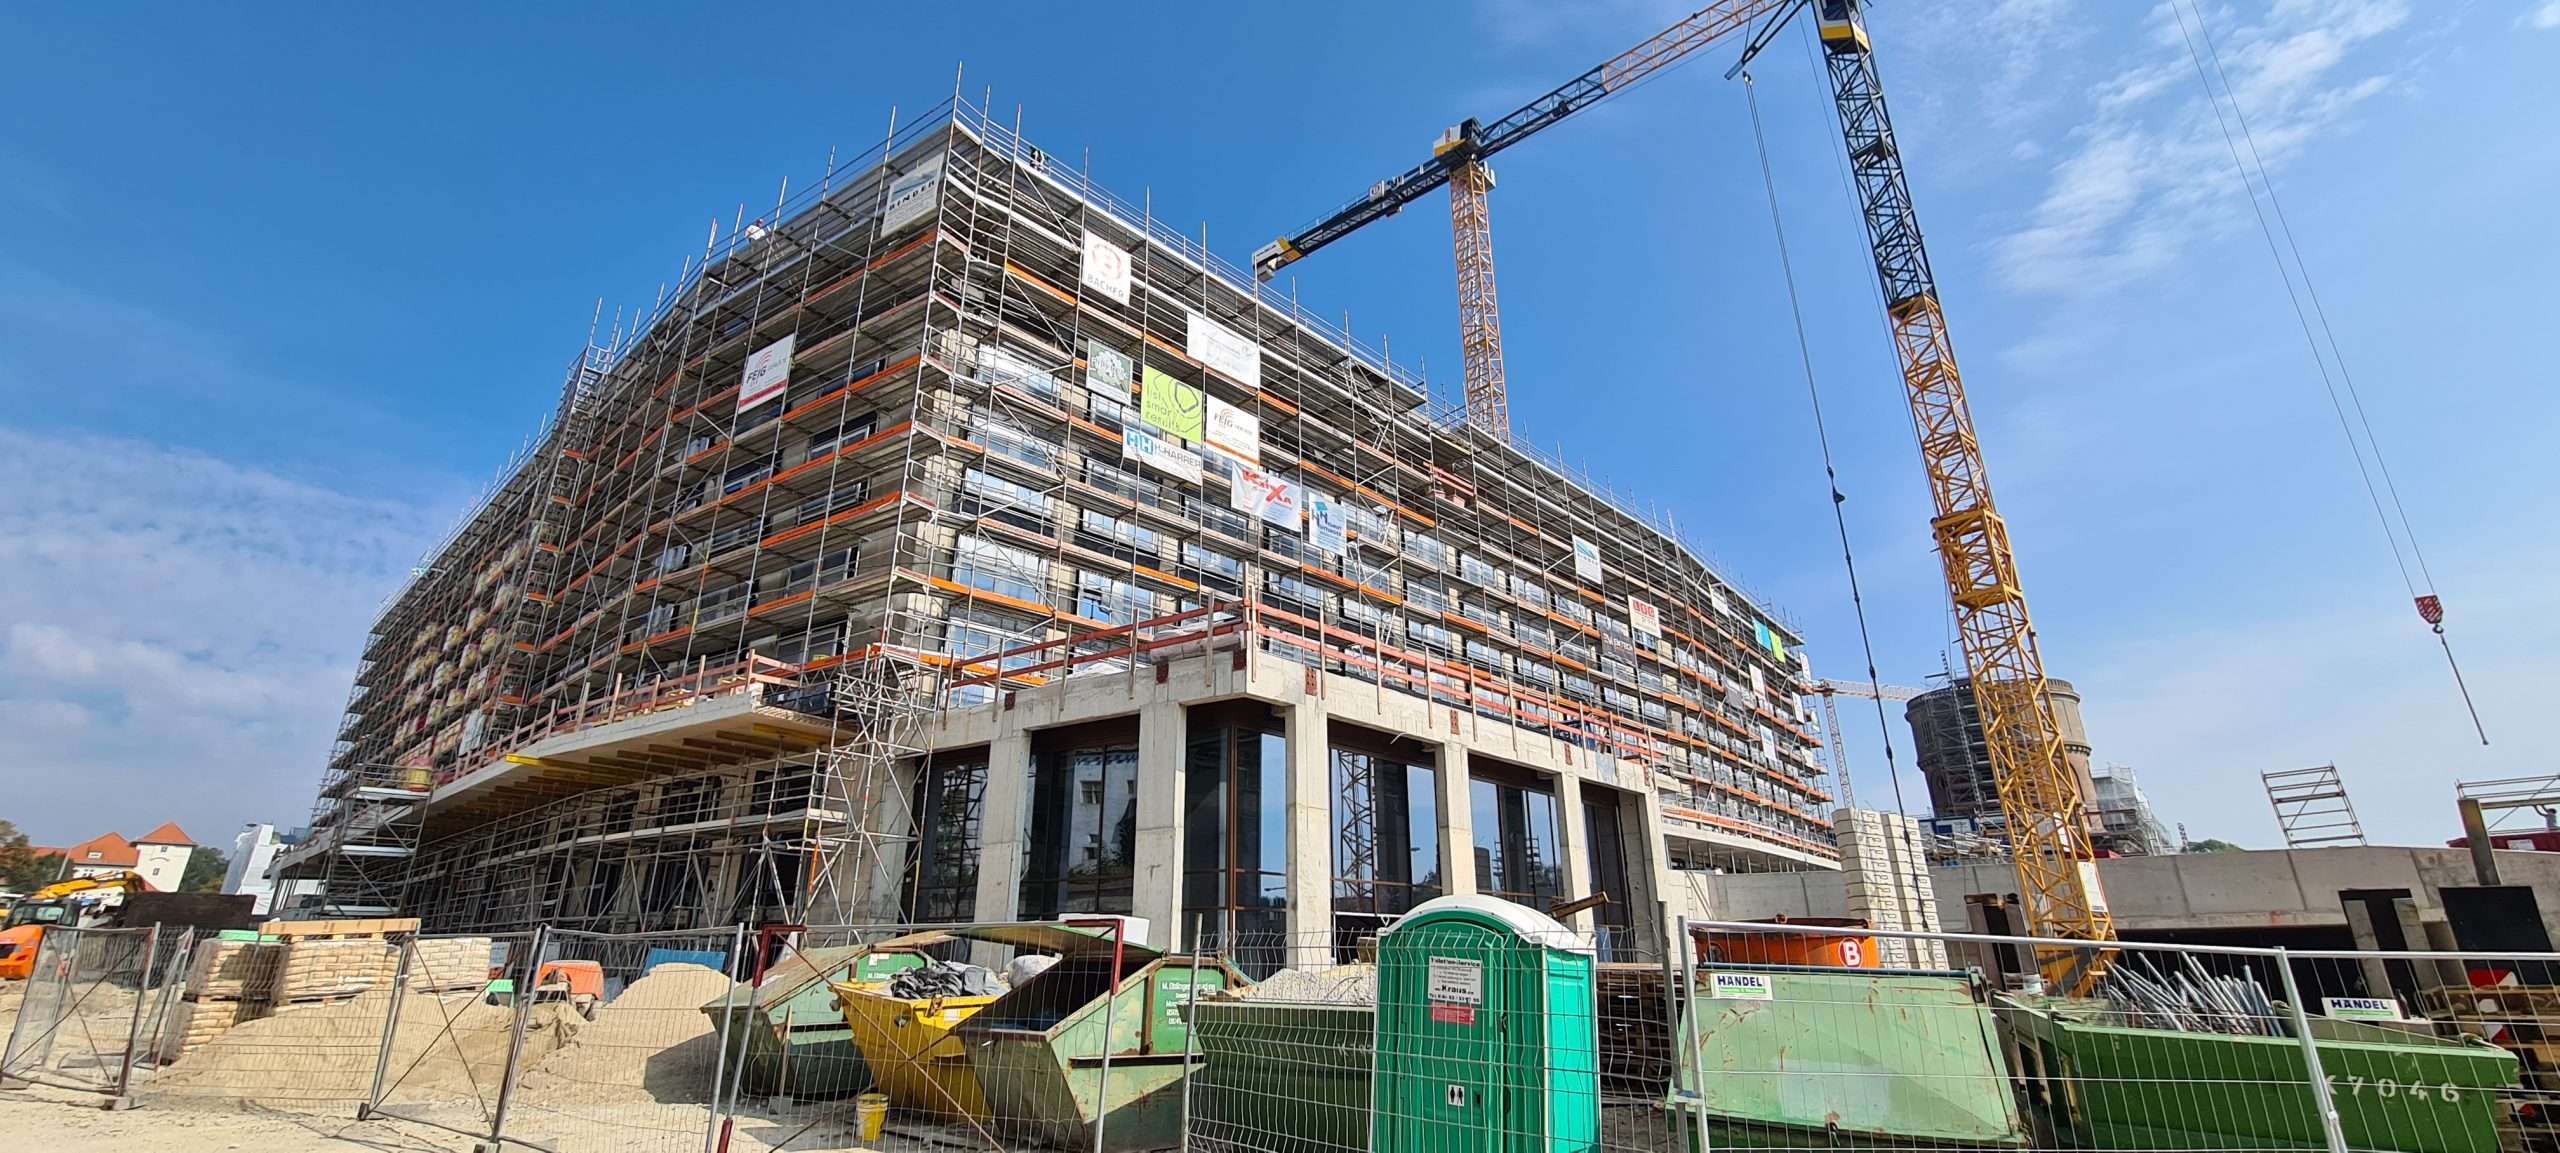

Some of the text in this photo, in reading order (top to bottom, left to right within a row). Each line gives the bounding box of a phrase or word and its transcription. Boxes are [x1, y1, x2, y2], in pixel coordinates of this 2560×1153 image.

[889, 180, 935, 211] BINDER
[1087, 273, 1124, 298] BACHER
[747, 365, 767, 384] FEIG
[1146, 384, 1161, 400] list
[1145, 412, 1180, 433] results
[1214, 413, 1233, 428] FEIG
[1842, 941, 1861, 966] B
